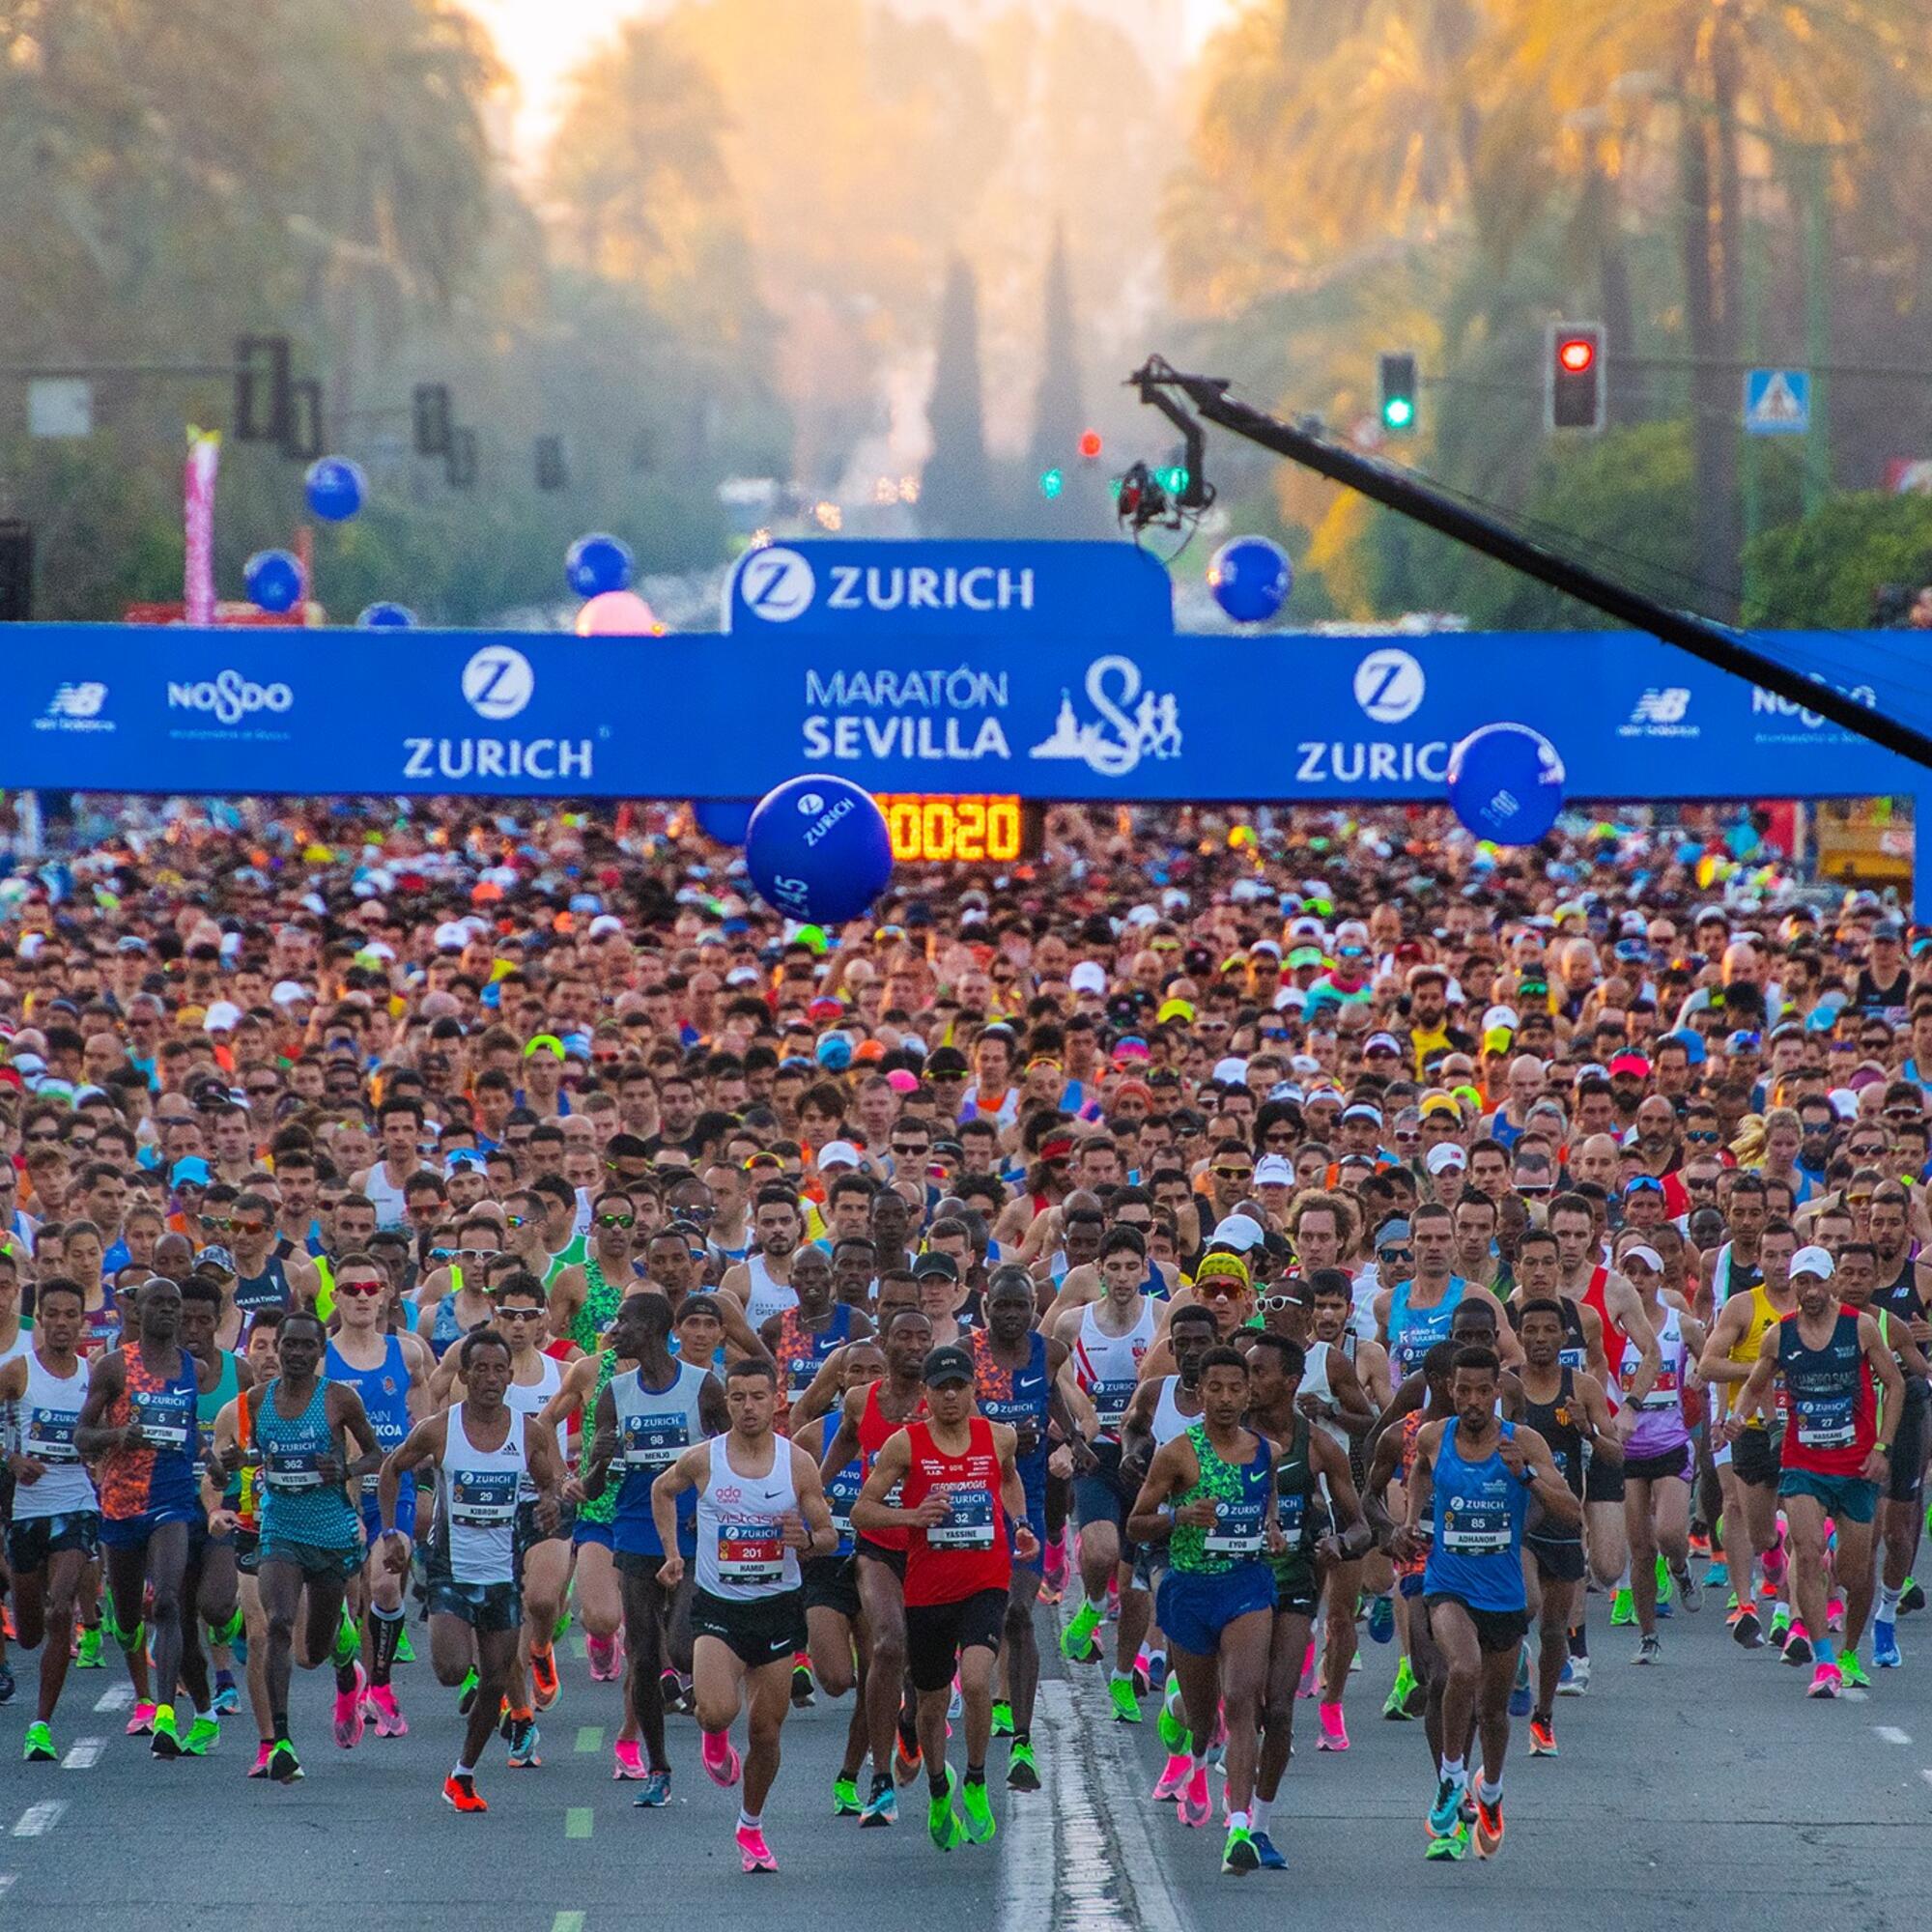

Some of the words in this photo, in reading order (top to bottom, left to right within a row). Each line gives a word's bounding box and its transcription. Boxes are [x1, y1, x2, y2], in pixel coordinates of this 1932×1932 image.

[827, 566, 1036, 611] ZURICH
[805, 663, 1009, 710] MARATÓN
[802, 715, 1012, 760] SEVILLA
[402, 737, 593, 780] ZURICH
[1295, 741, 1457, 783] ZURIC
[802, 797, 856, 848] ZURICH
[236, 1295, 284, 1306] MARATHON
[151, 1395, 186, 1406] ZURICH
[1112, 1399, 1124, 1408] 47
[1001, 1403, 1034, 1413] ZURICH
[52, 1413, 79, 1424] ZURIC
[157, 1413, 166, 1423] 5
[643, 1416, 680, 1428] ZURICH
[1821, 1418, 1833, 1428] 27
[55, 1430, 69, 1439] 26
[649, 1435, 664, 1446] 98
[279, 1441, 316, 1453] ZURICH
[644, 1451, 670, 1461] MENJO
[284, 1460, 303, 1469] 362
[475, 1474, 511, 1485] ZURICH
[479, 1492, 494, 1502] 29
[1465, 1499, 1505, 1510] ZURICH
[954, 1513, 969, 1523] 32
[1470, 1518, 1486, 1528] 85
[741, 1529, 778, 1539] ZURICH
[943, 1529, 978, 1539] YASSINE
[1234, 1524, 1248, 1534] 34
[742, 1548, 762, 1558] 201
